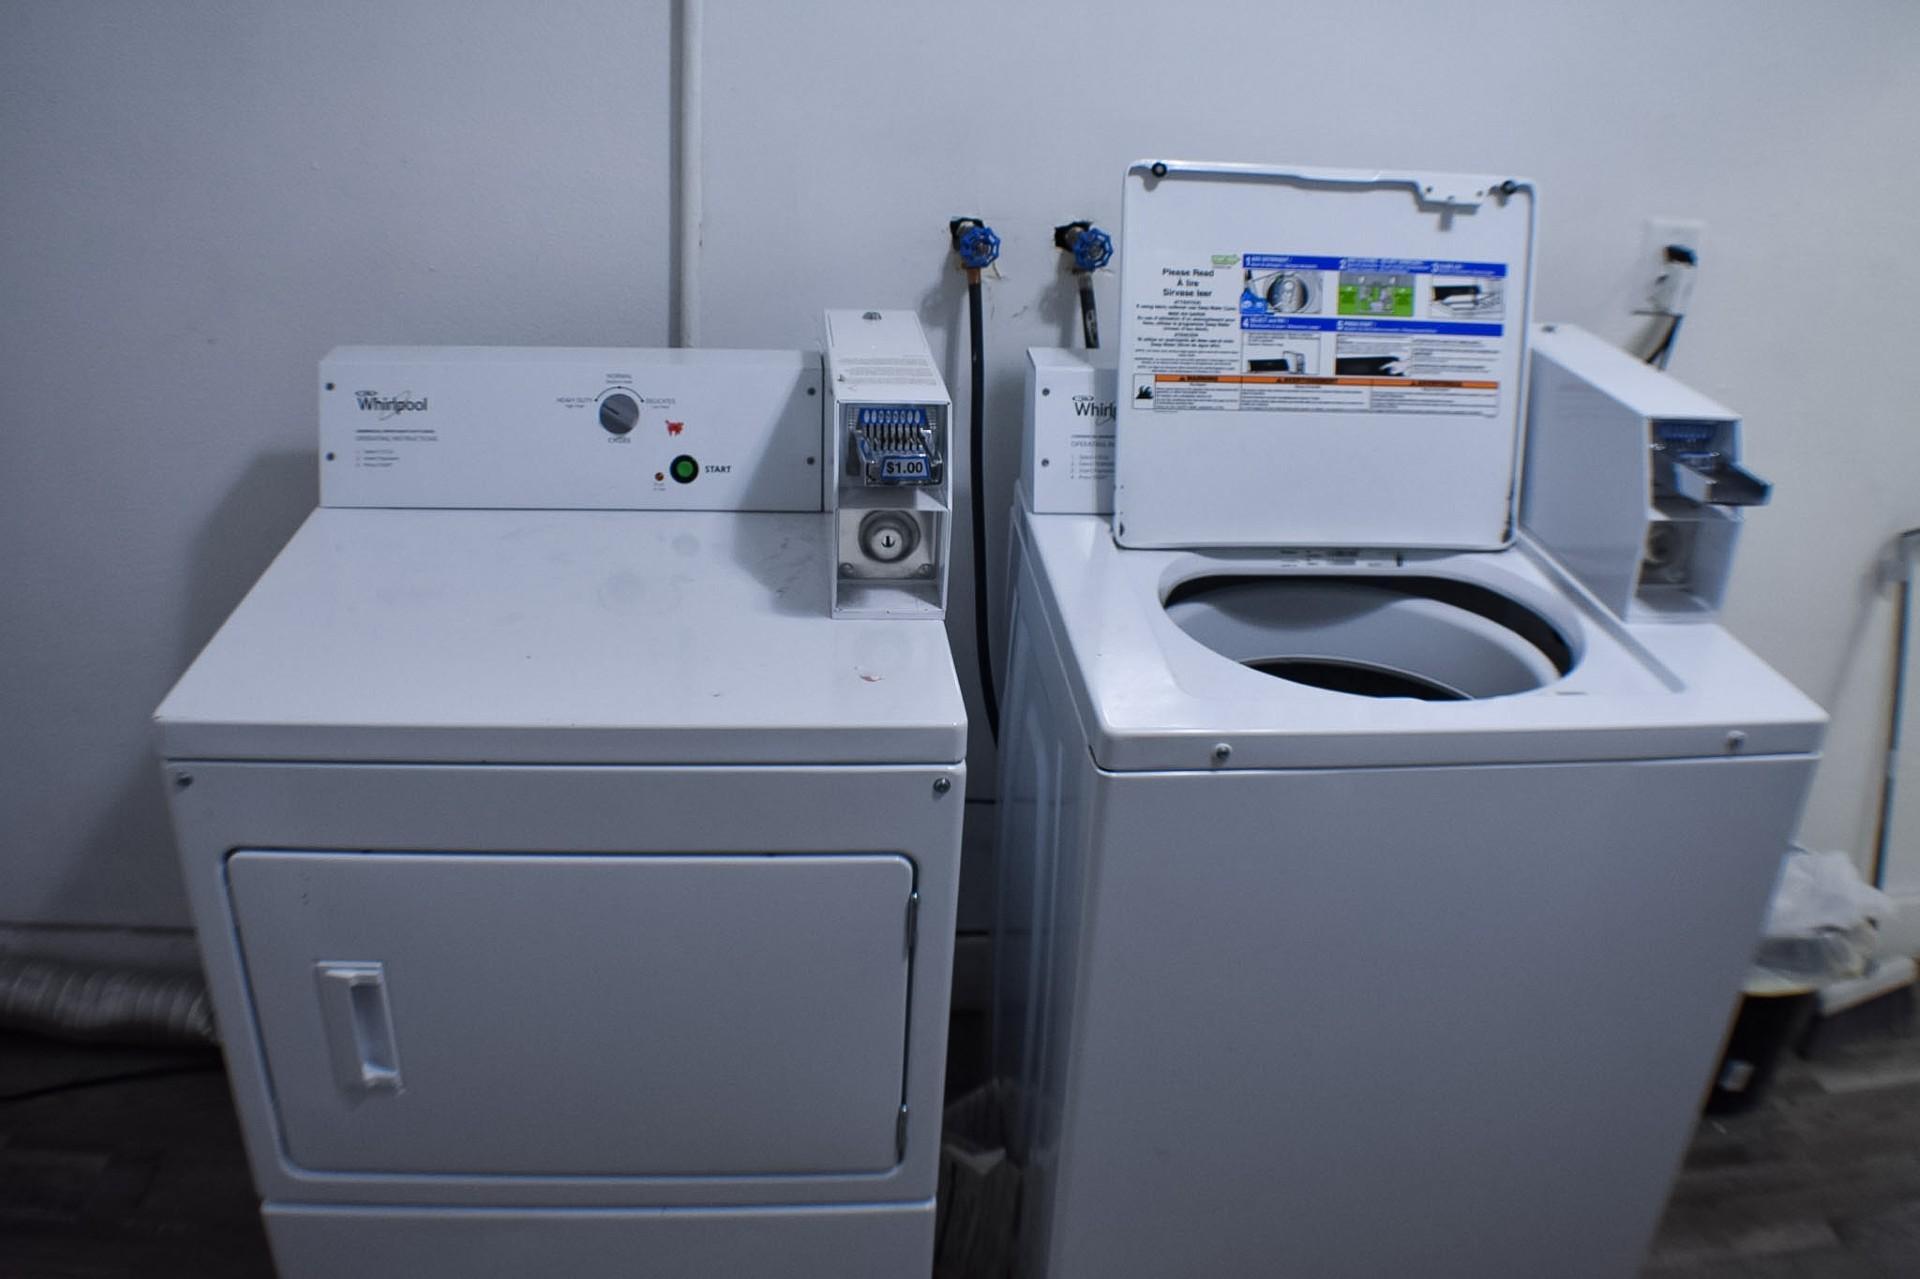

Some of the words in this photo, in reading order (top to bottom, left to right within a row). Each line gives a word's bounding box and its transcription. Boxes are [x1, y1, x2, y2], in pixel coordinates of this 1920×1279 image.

[1162, 268, 1190, 276] Please
[1193, 269, 1214, 277] Read
[356, 397, 428, 415] Whirlpool
[704, 465, 731, 473] START
[886, 461, 923, 474] $1.00
